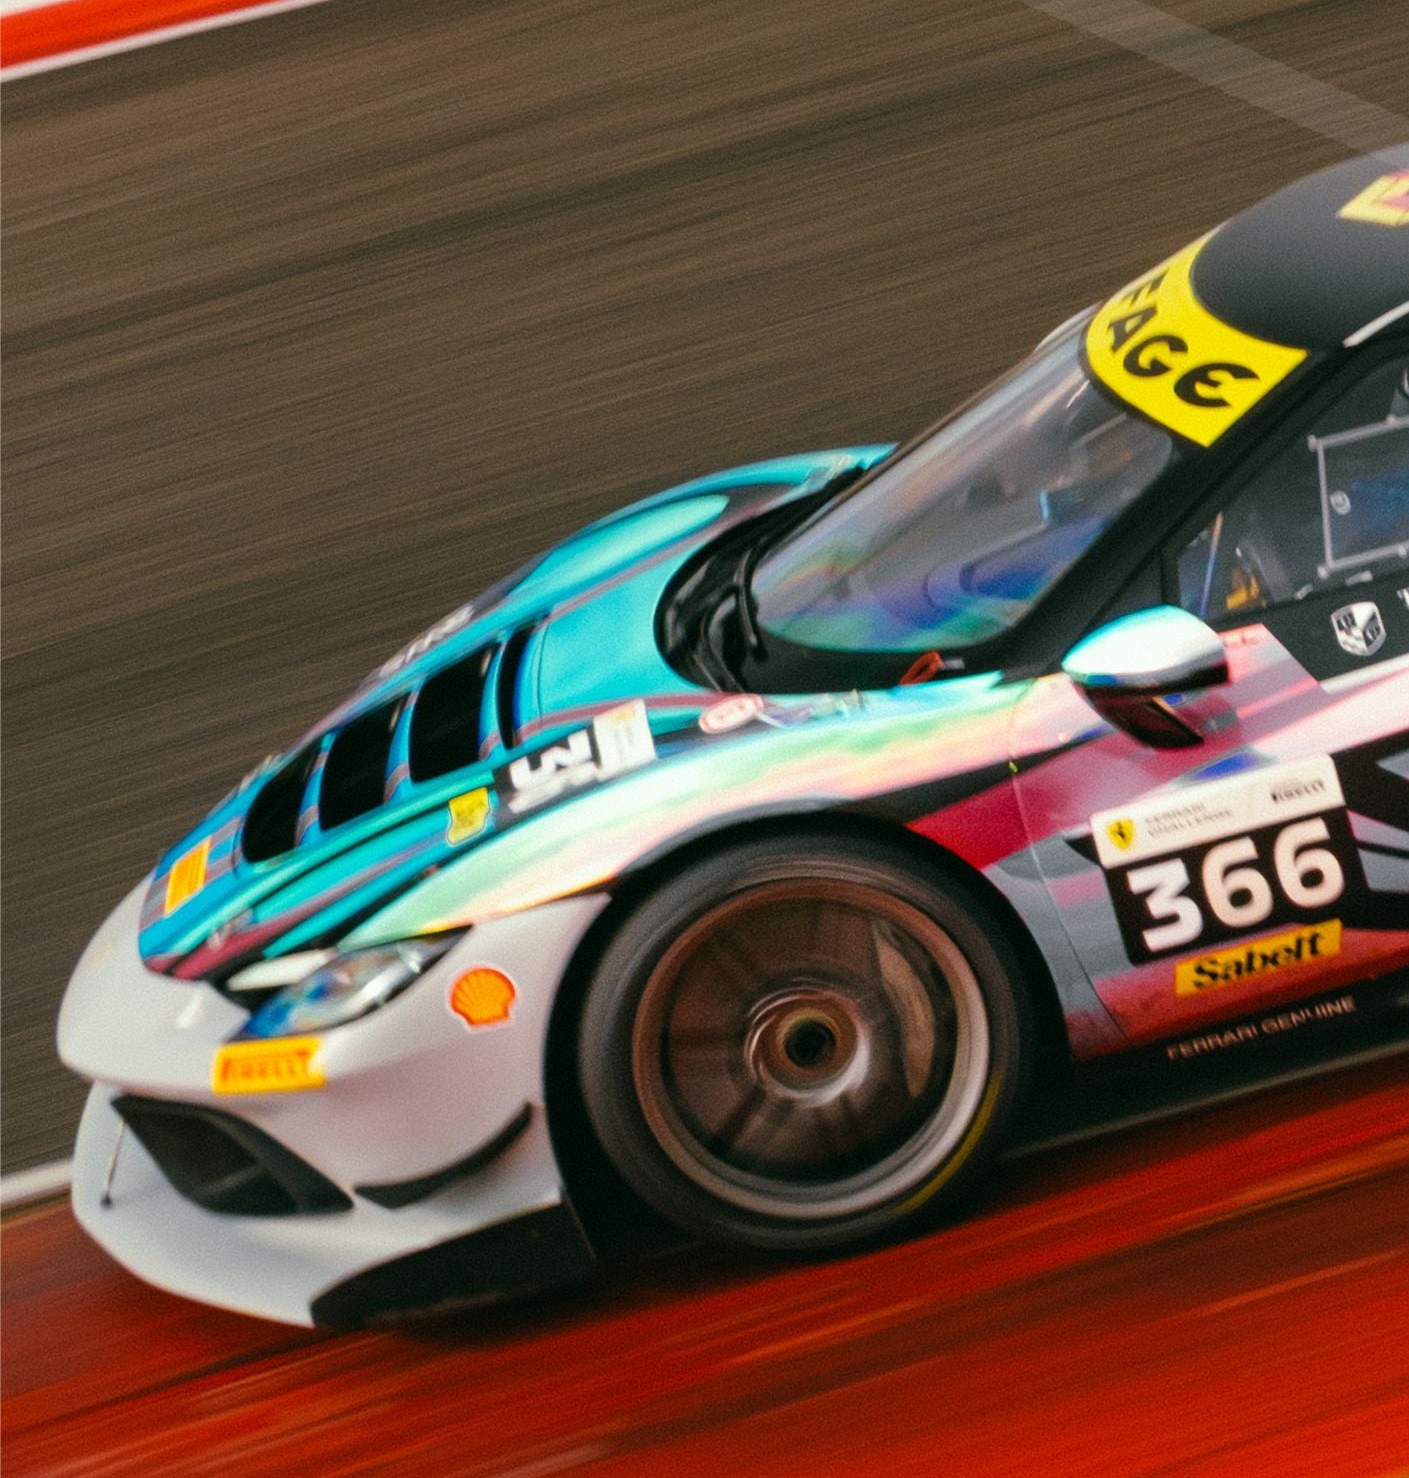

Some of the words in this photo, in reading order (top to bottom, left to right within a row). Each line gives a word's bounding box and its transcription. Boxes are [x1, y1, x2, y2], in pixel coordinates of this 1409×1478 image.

[1126, 816, 1345, 953] 366
[1193, 931, 1324, 989] Sabelt
[1167, 1025, 1260, 1061] FERRARI
[1261, 995, 1358, 1034] GENUINE
